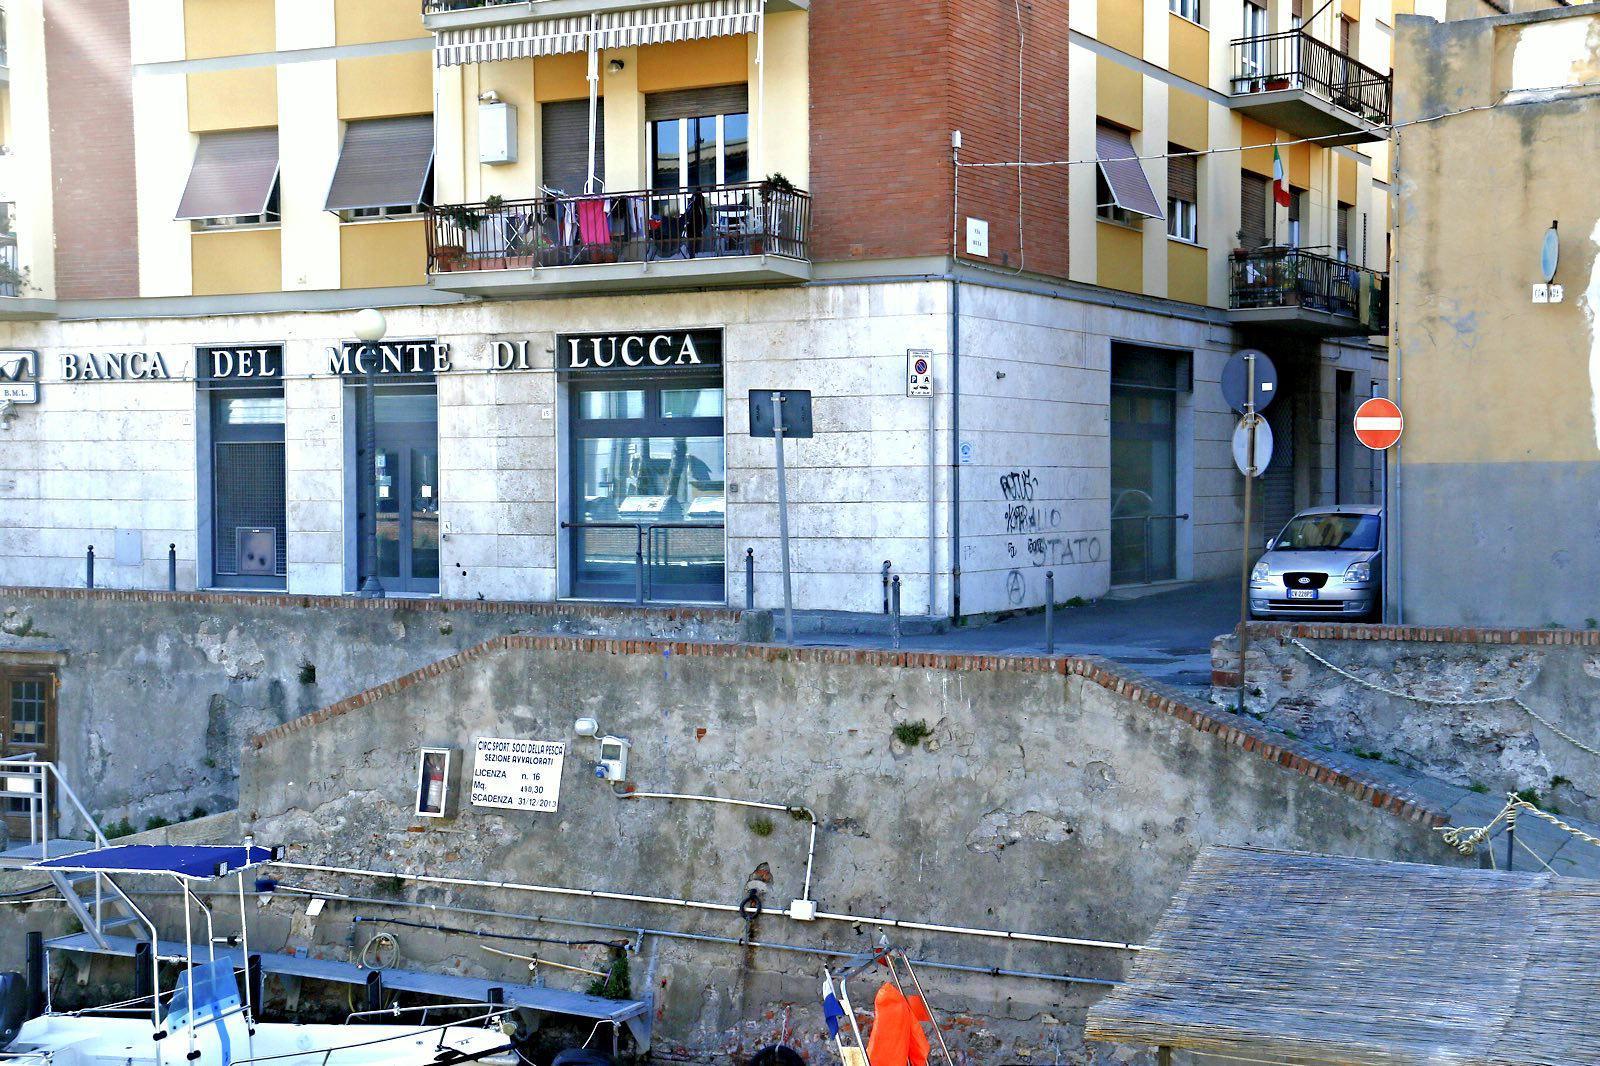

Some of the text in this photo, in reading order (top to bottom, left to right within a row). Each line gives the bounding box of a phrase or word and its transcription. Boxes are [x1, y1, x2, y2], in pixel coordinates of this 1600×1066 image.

[60, 352, 168, 380] BANCA
[211, 350, 275, 377] DEL
[490, 340, 529, 370] DI
[568, 334, 701, 368] LUCCA
[4, 389, 28, 397] B.M.L.
[512, 743, 527, 753] SOCI
[528, 743, 545, 754] DELLA
[546, 745, 563, 755] PESCA
[484, 754, 554, 765] SEZIONE AVVALORATI
[475, 768, 507, 778] LICENZA
[533, 772, 541, 780] 16
[472, 793, 513, 804] SCADENZA
